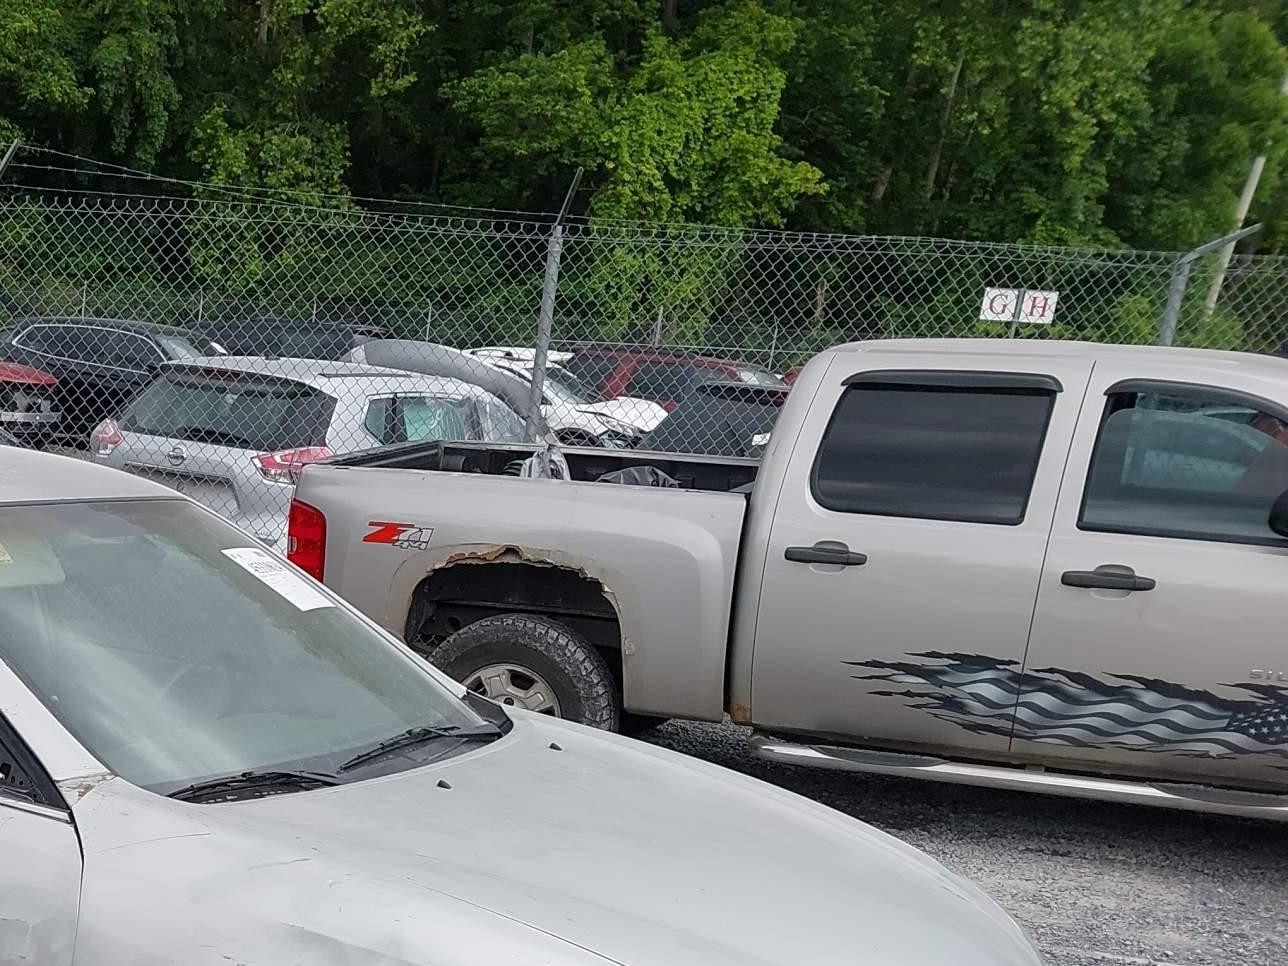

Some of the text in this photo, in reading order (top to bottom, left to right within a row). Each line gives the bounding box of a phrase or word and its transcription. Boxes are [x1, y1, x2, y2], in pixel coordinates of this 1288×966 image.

[989, 293, 1008, 315] G
[1029, 296, 1050, 317] H
[362, 521, 434, 544] Z71
